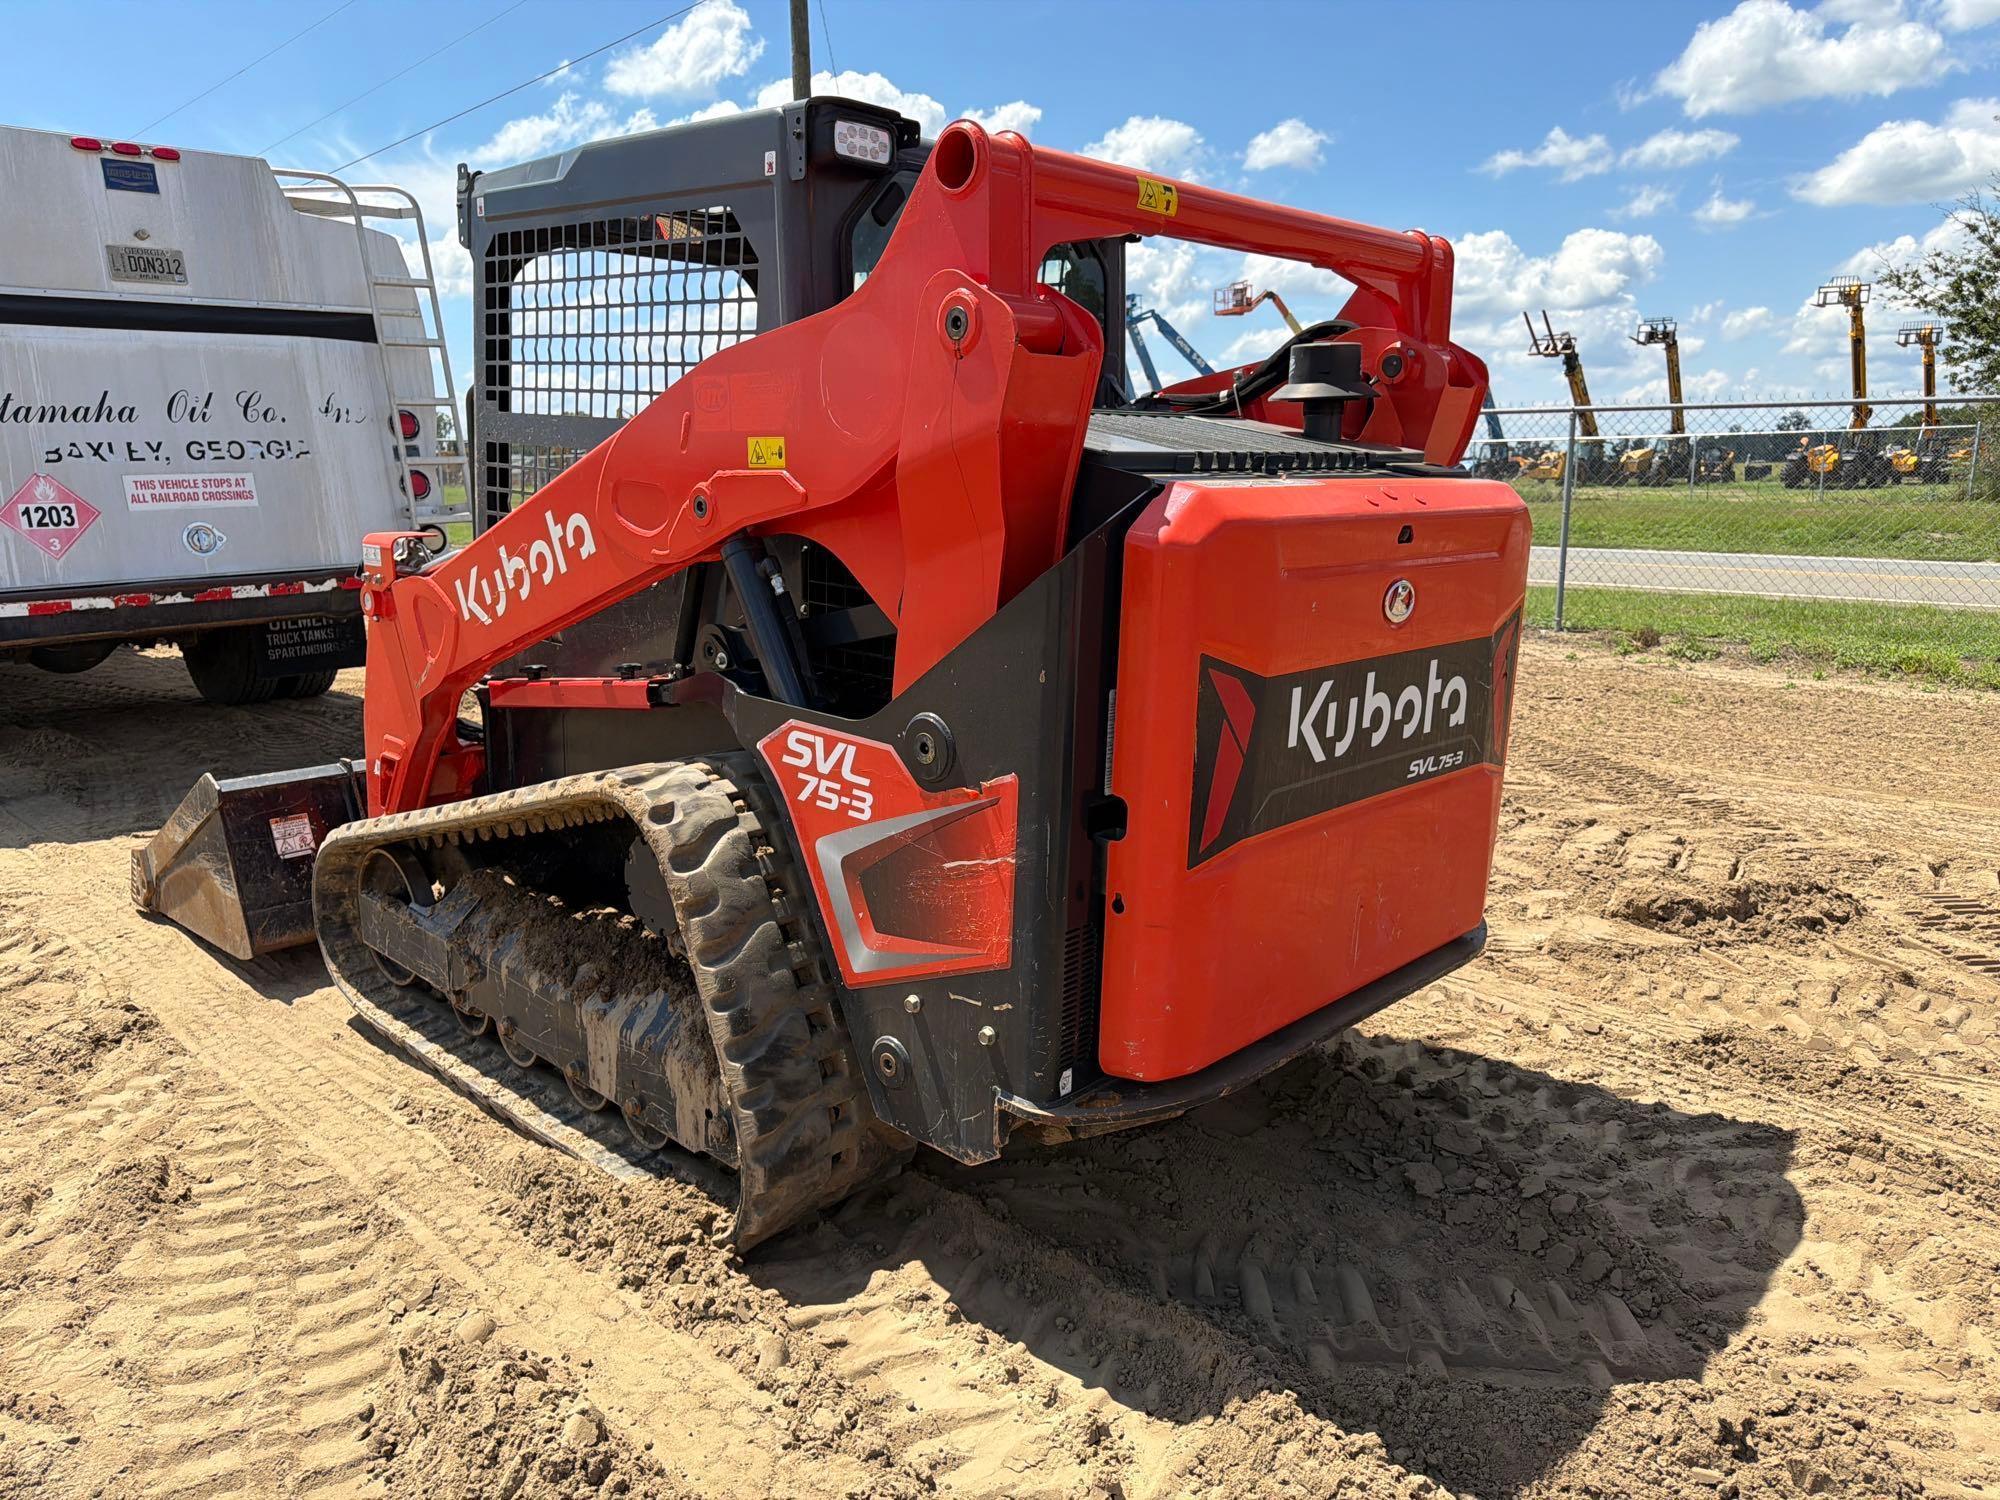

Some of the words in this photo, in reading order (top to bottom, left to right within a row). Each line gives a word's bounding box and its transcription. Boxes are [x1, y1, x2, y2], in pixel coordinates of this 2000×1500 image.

[124, 247, 167, 257] GEORGIA
[167, 389, 213, 423] Oil
[236, 390, 286, 423] Co.
[133, 480, 157, 491] THIS
[158, 478, 200, 490] VEHICLE
[201, 477, 233, 489] STOPS
[234, 477, 247, 488] AT
[131, 493, 149, 504] ALL
[151, 491, 200, 504] RAILROAD
[201, 489, 255, 501] CROSSINGS
[21, 505, 75, 528] 1203
[48, 537, 61, 551] 3
[454, 510, 597, 626] Kubota
[266, 631, 301, 647] TRUCK
[301, 627, 335, 642] TANKS
[1287, 658, 1468, 763] Kubota
[781, 730, 871, 787] SVL
[797, 772, 874, 821] 75-3
